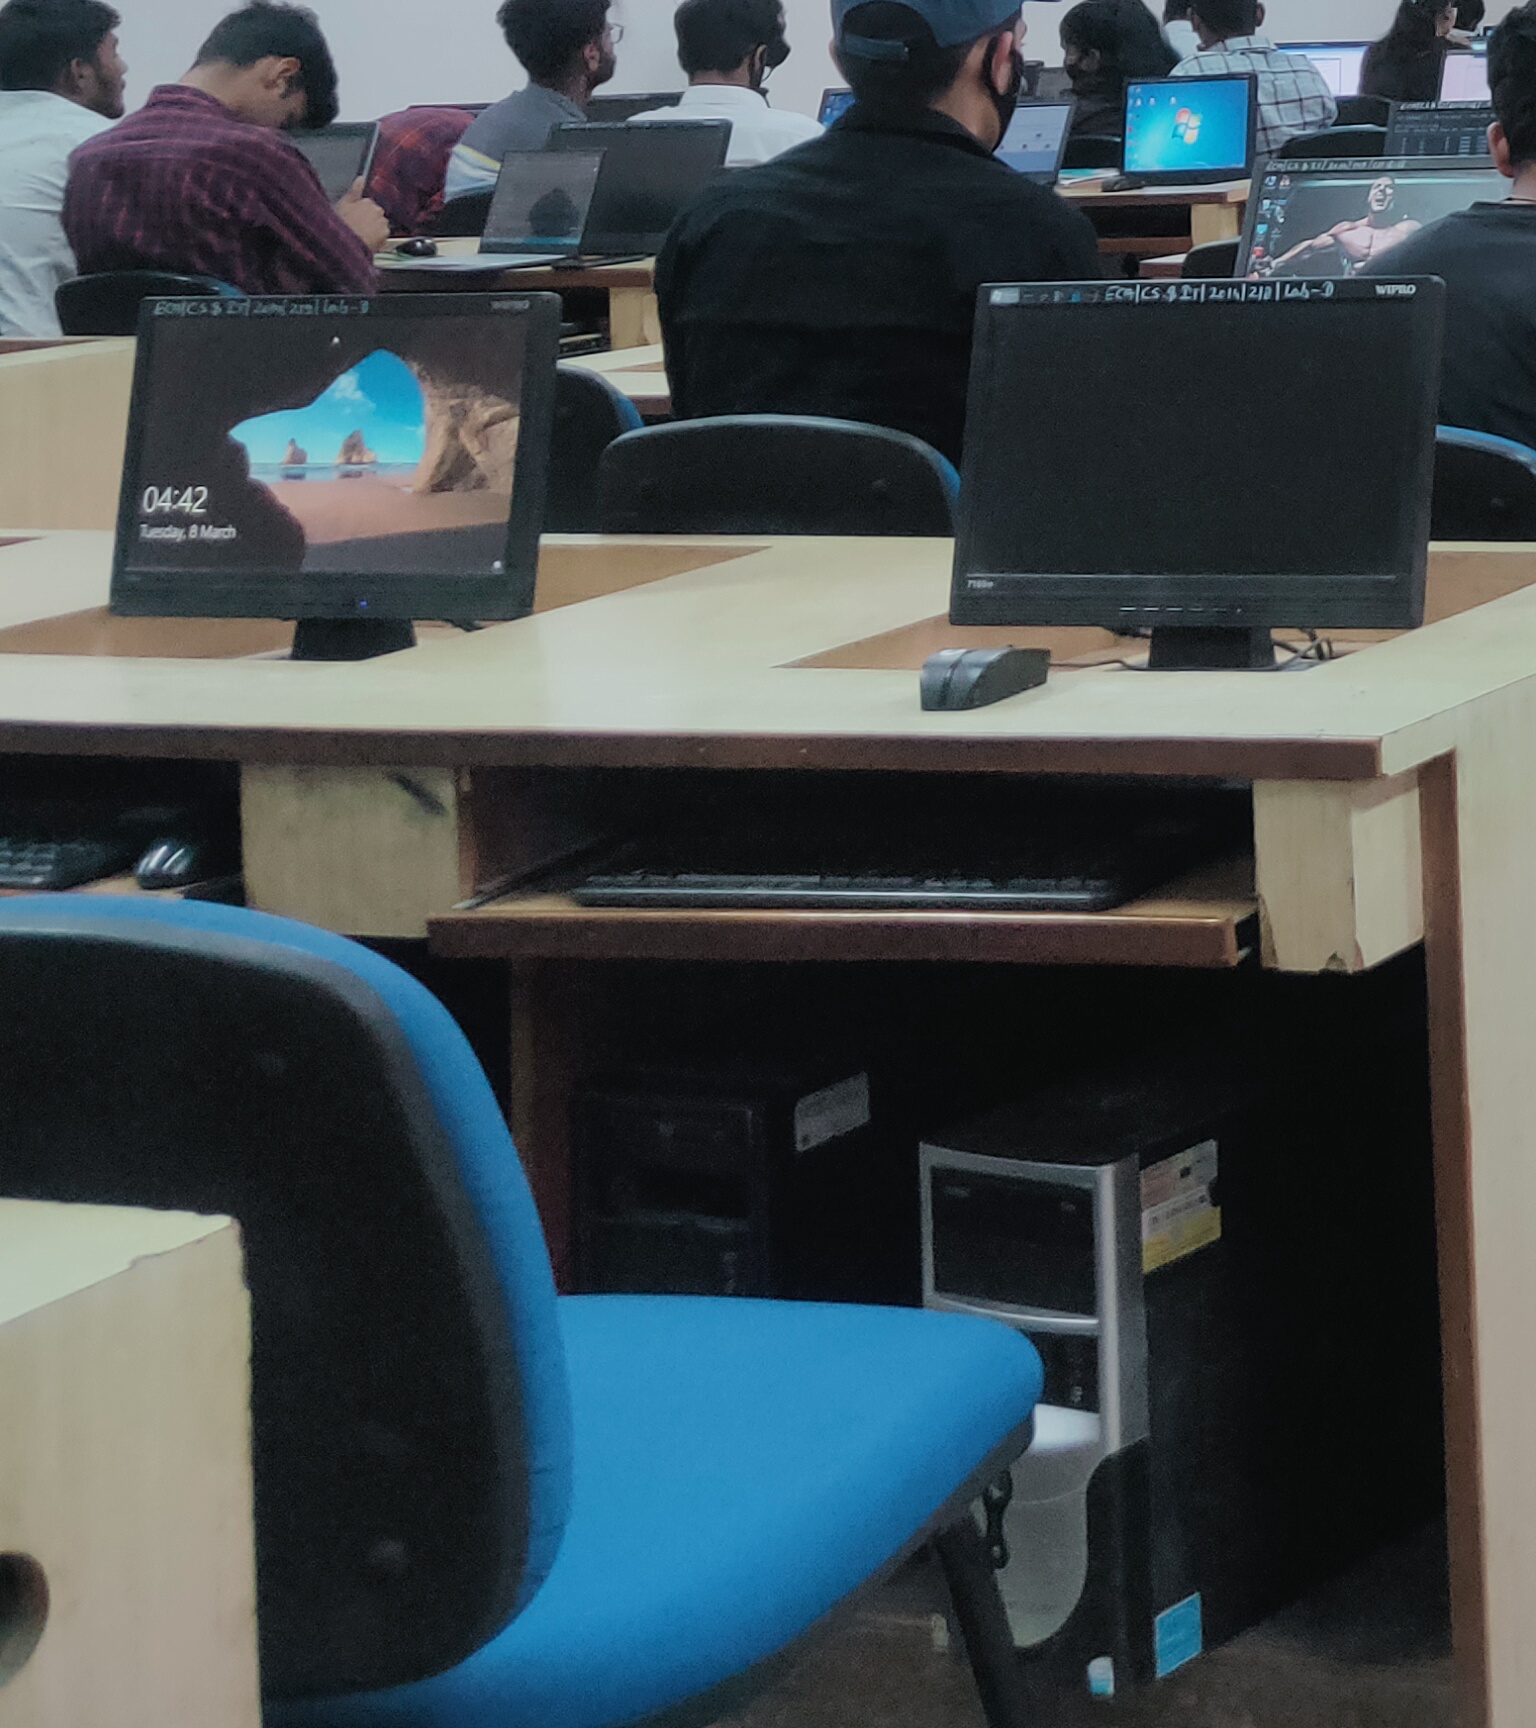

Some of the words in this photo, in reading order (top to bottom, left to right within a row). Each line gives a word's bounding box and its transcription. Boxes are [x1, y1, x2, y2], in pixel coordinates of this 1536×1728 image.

[1375, 283, 1417, 296] WIPRO
[142, 486, 208, 513] 04:42
[140, 523, 187, 542] Tuesday,
[188, 523, 198, 539] 8
[199, 524, 237, 540] March
